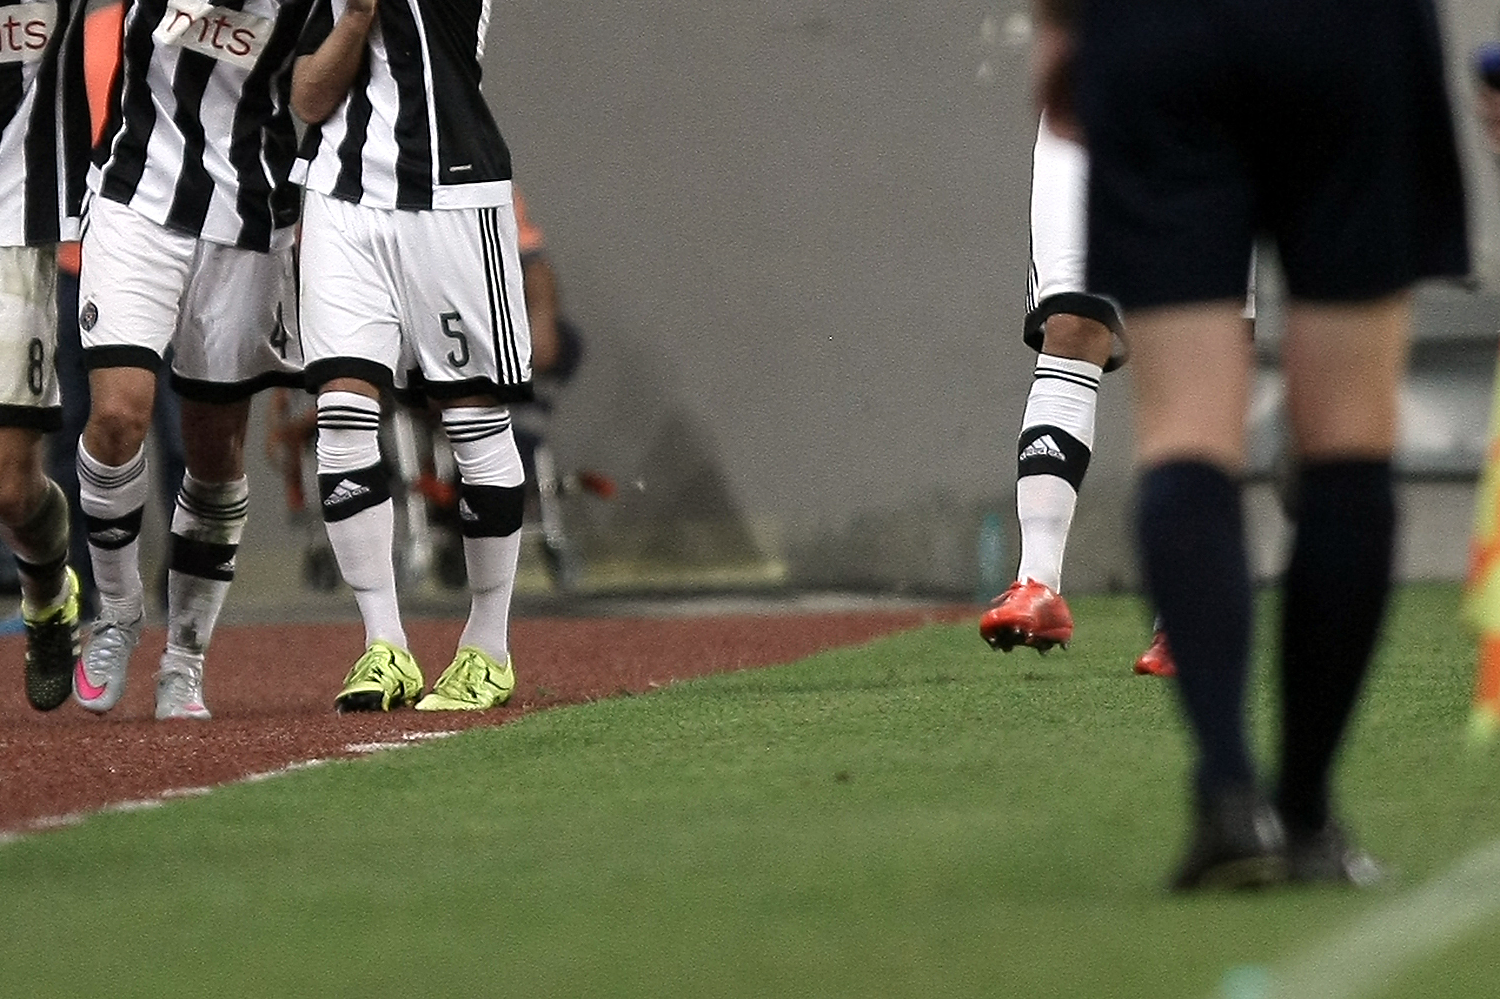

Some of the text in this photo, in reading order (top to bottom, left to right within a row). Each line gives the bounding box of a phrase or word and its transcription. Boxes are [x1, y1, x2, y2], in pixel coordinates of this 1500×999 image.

[165, 9, 256, 56] mts
[269, 301, 288, 359] 4
[439, 311, 470, 368] 5
[27, 337, 44, 396] 8
